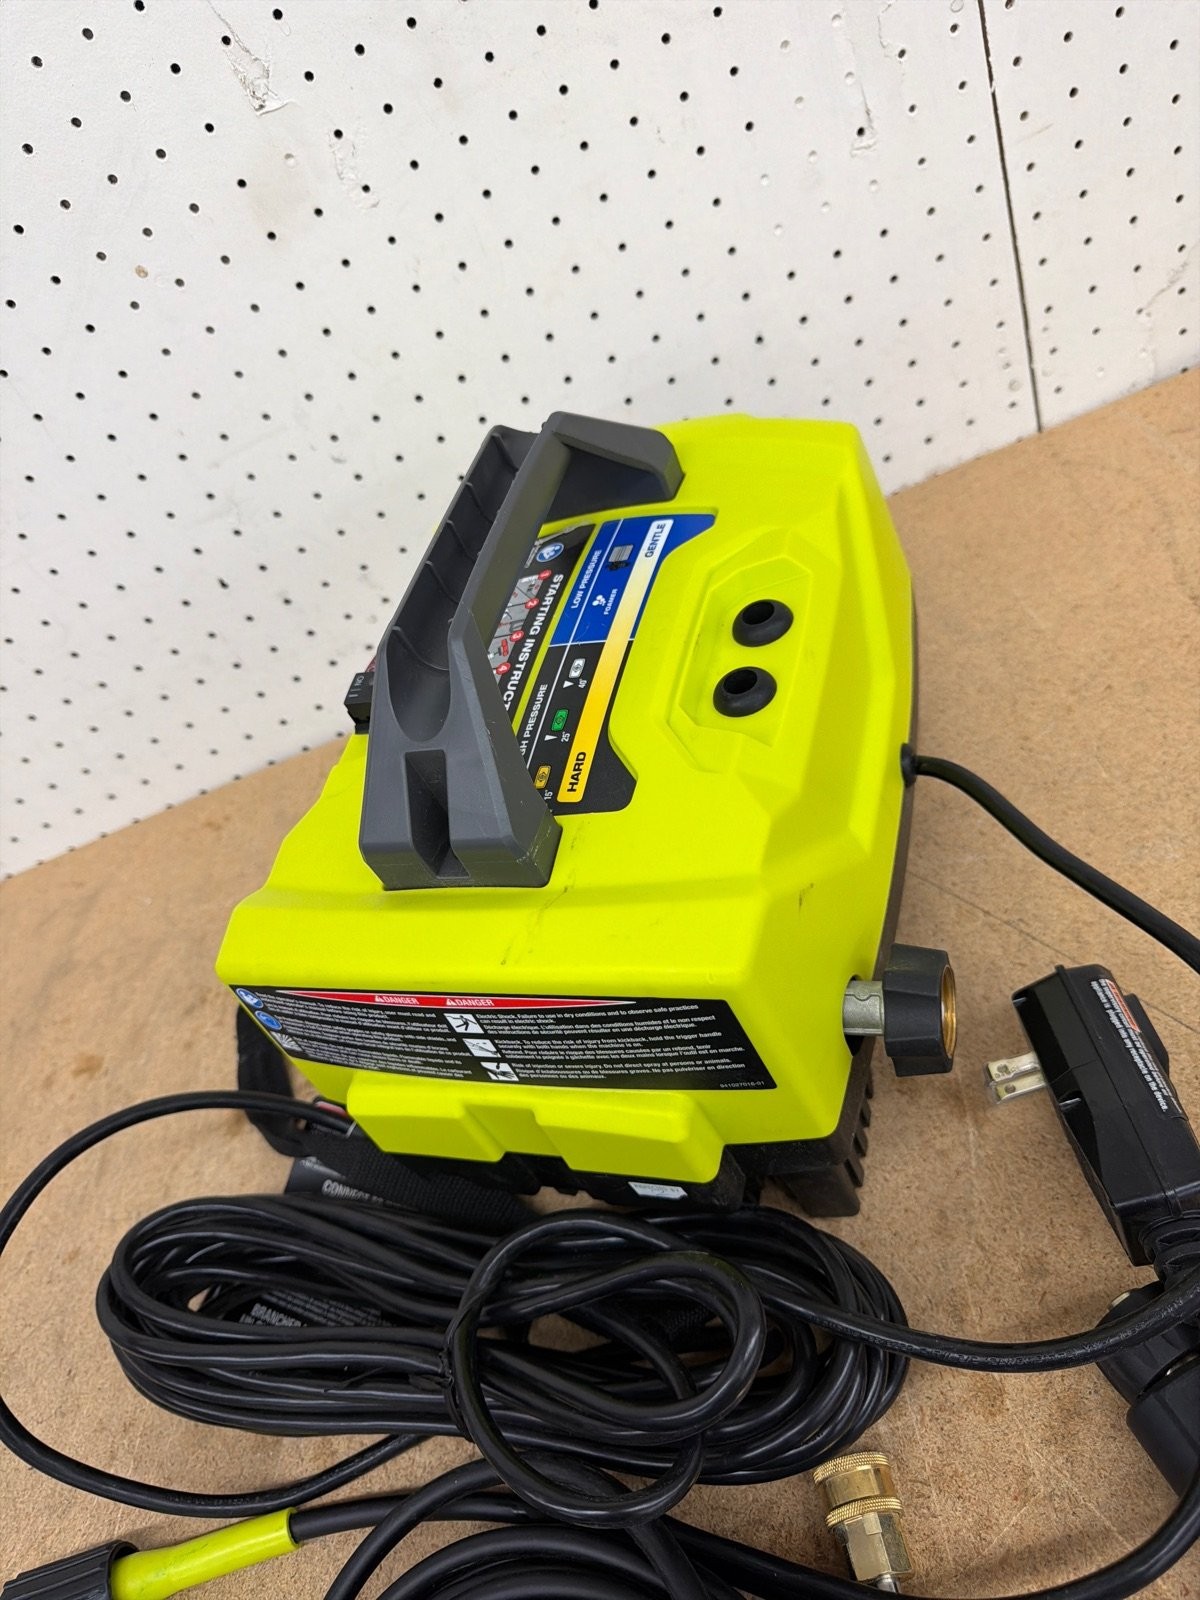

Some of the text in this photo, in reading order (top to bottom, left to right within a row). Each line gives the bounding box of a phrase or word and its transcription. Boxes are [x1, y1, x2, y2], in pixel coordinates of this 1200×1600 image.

[645, 523, 666, 558] GENTLE
[571, 549, 602, 608] LOW PRESSURE
[530, 574, 564, 635] STARTING
[604, 589, 618, 615] FOAMER
[524, 684, 548, 738] PRESSURE
[567, 752, 586, 792] HARD
[383, 996, 420, 1005] DANGER
[668, 1004, 699, 1012] practices
[1129, 1047, 1148, 1075] receptacle
[1148, 1080, 1158, 1091] the
[1154, 1090, 1168, 1112] device.
